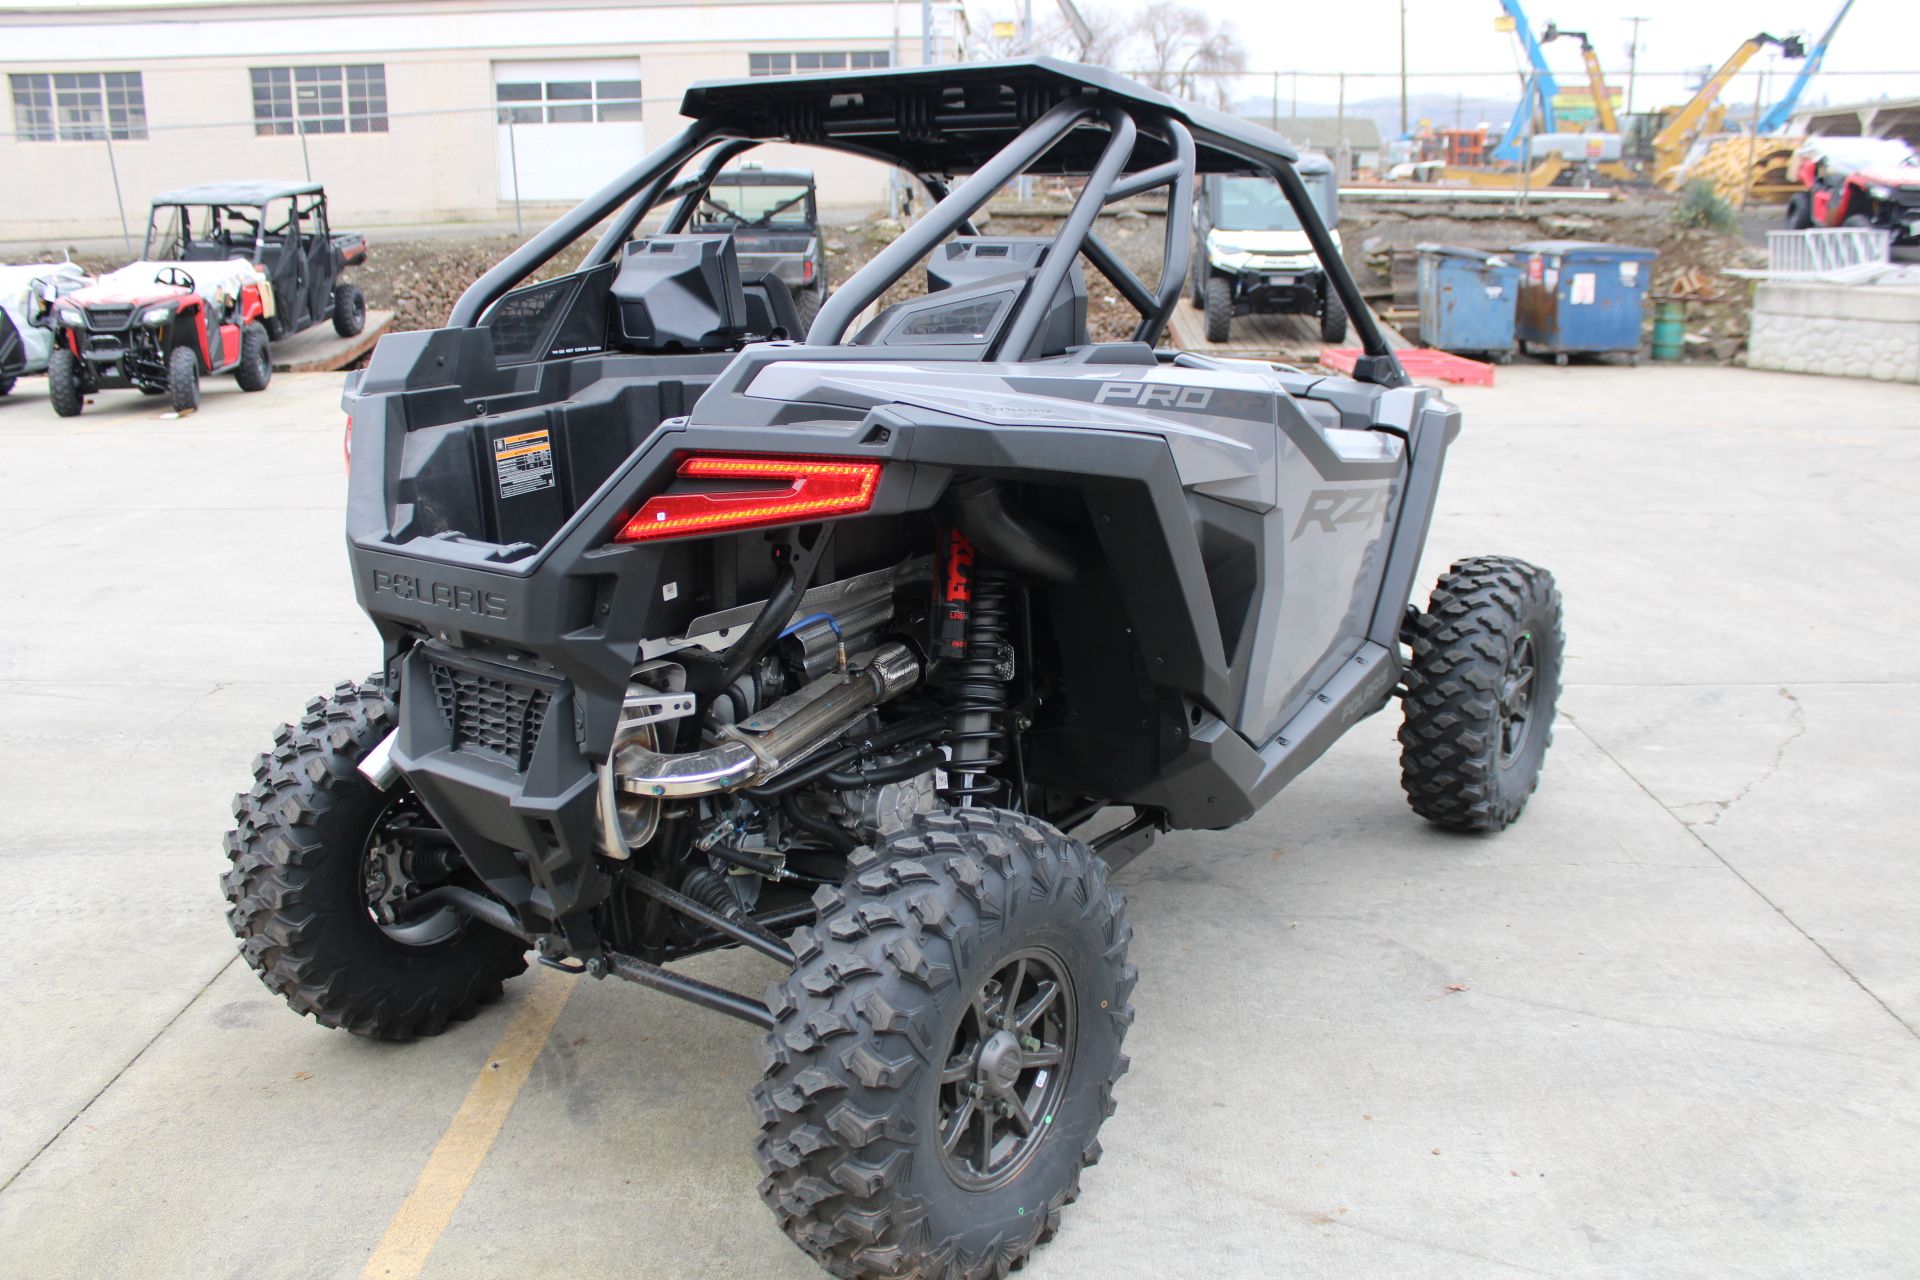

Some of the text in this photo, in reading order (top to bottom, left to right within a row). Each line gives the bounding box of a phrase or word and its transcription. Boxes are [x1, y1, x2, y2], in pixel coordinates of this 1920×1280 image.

[1093, 381, 1214, 409] PRO
[1290, 484, 1398, 543] RZR
[372, 569, 507, 620] POLARIS
